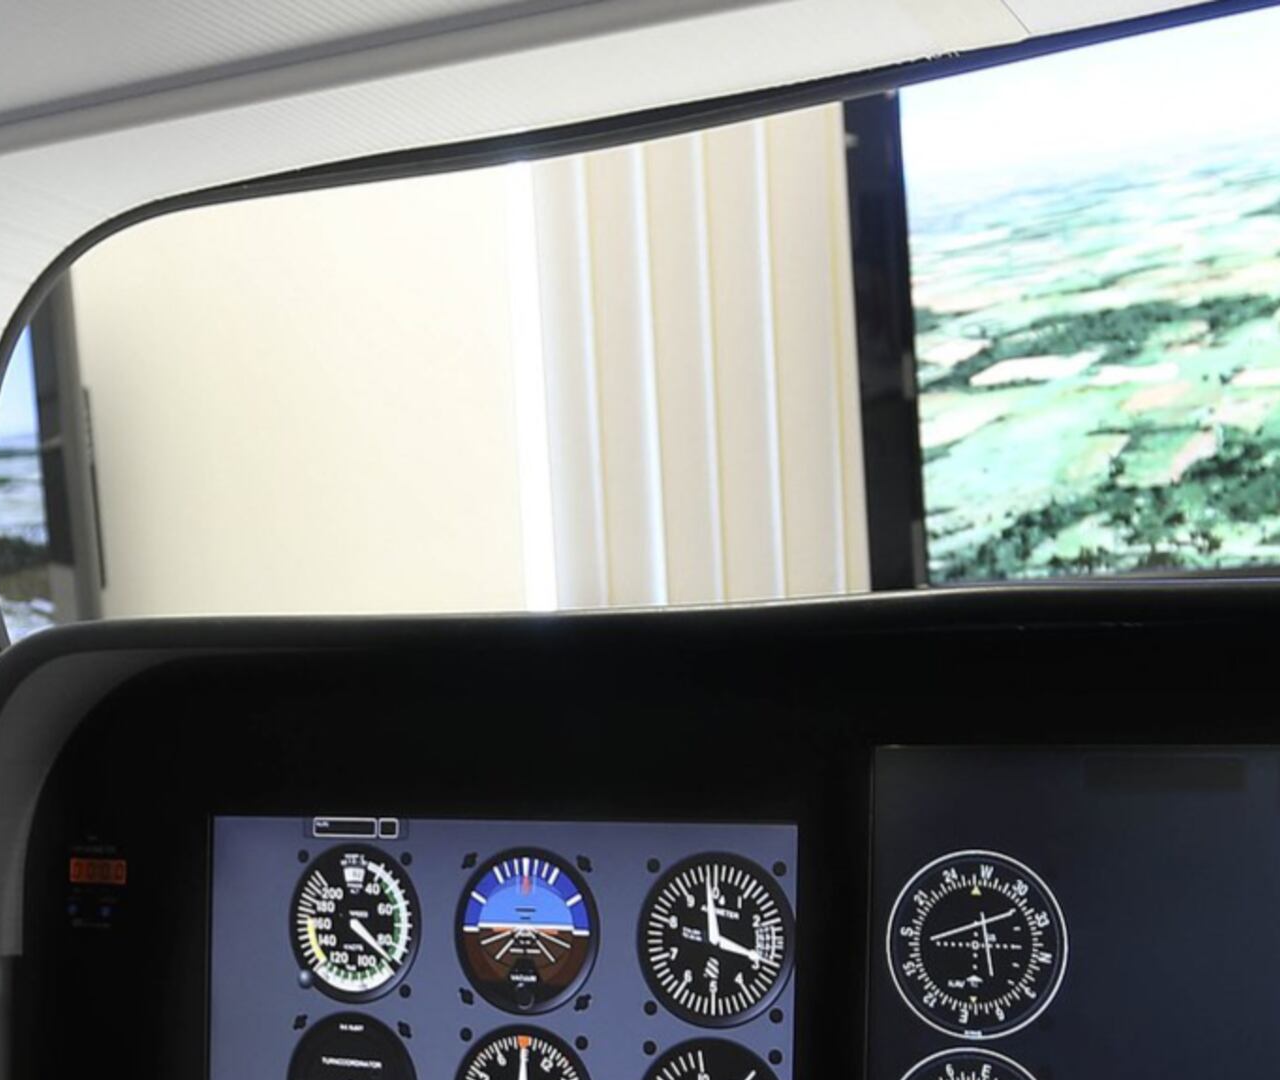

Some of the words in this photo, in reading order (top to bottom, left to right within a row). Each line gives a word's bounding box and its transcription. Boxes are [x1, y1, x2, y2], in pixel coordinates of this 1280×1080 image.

[322, 887, 344, 900] 200
[365, 883, 380, 895] 40
[317, 900, 335, 913] 180
[377, 903, 393, 916] 60
[318, 934, 337, 947] 140
[376, 934, 393, 946] 80
[329, 951, 349, 964] 120
[357, 953, 377, 967] 100
